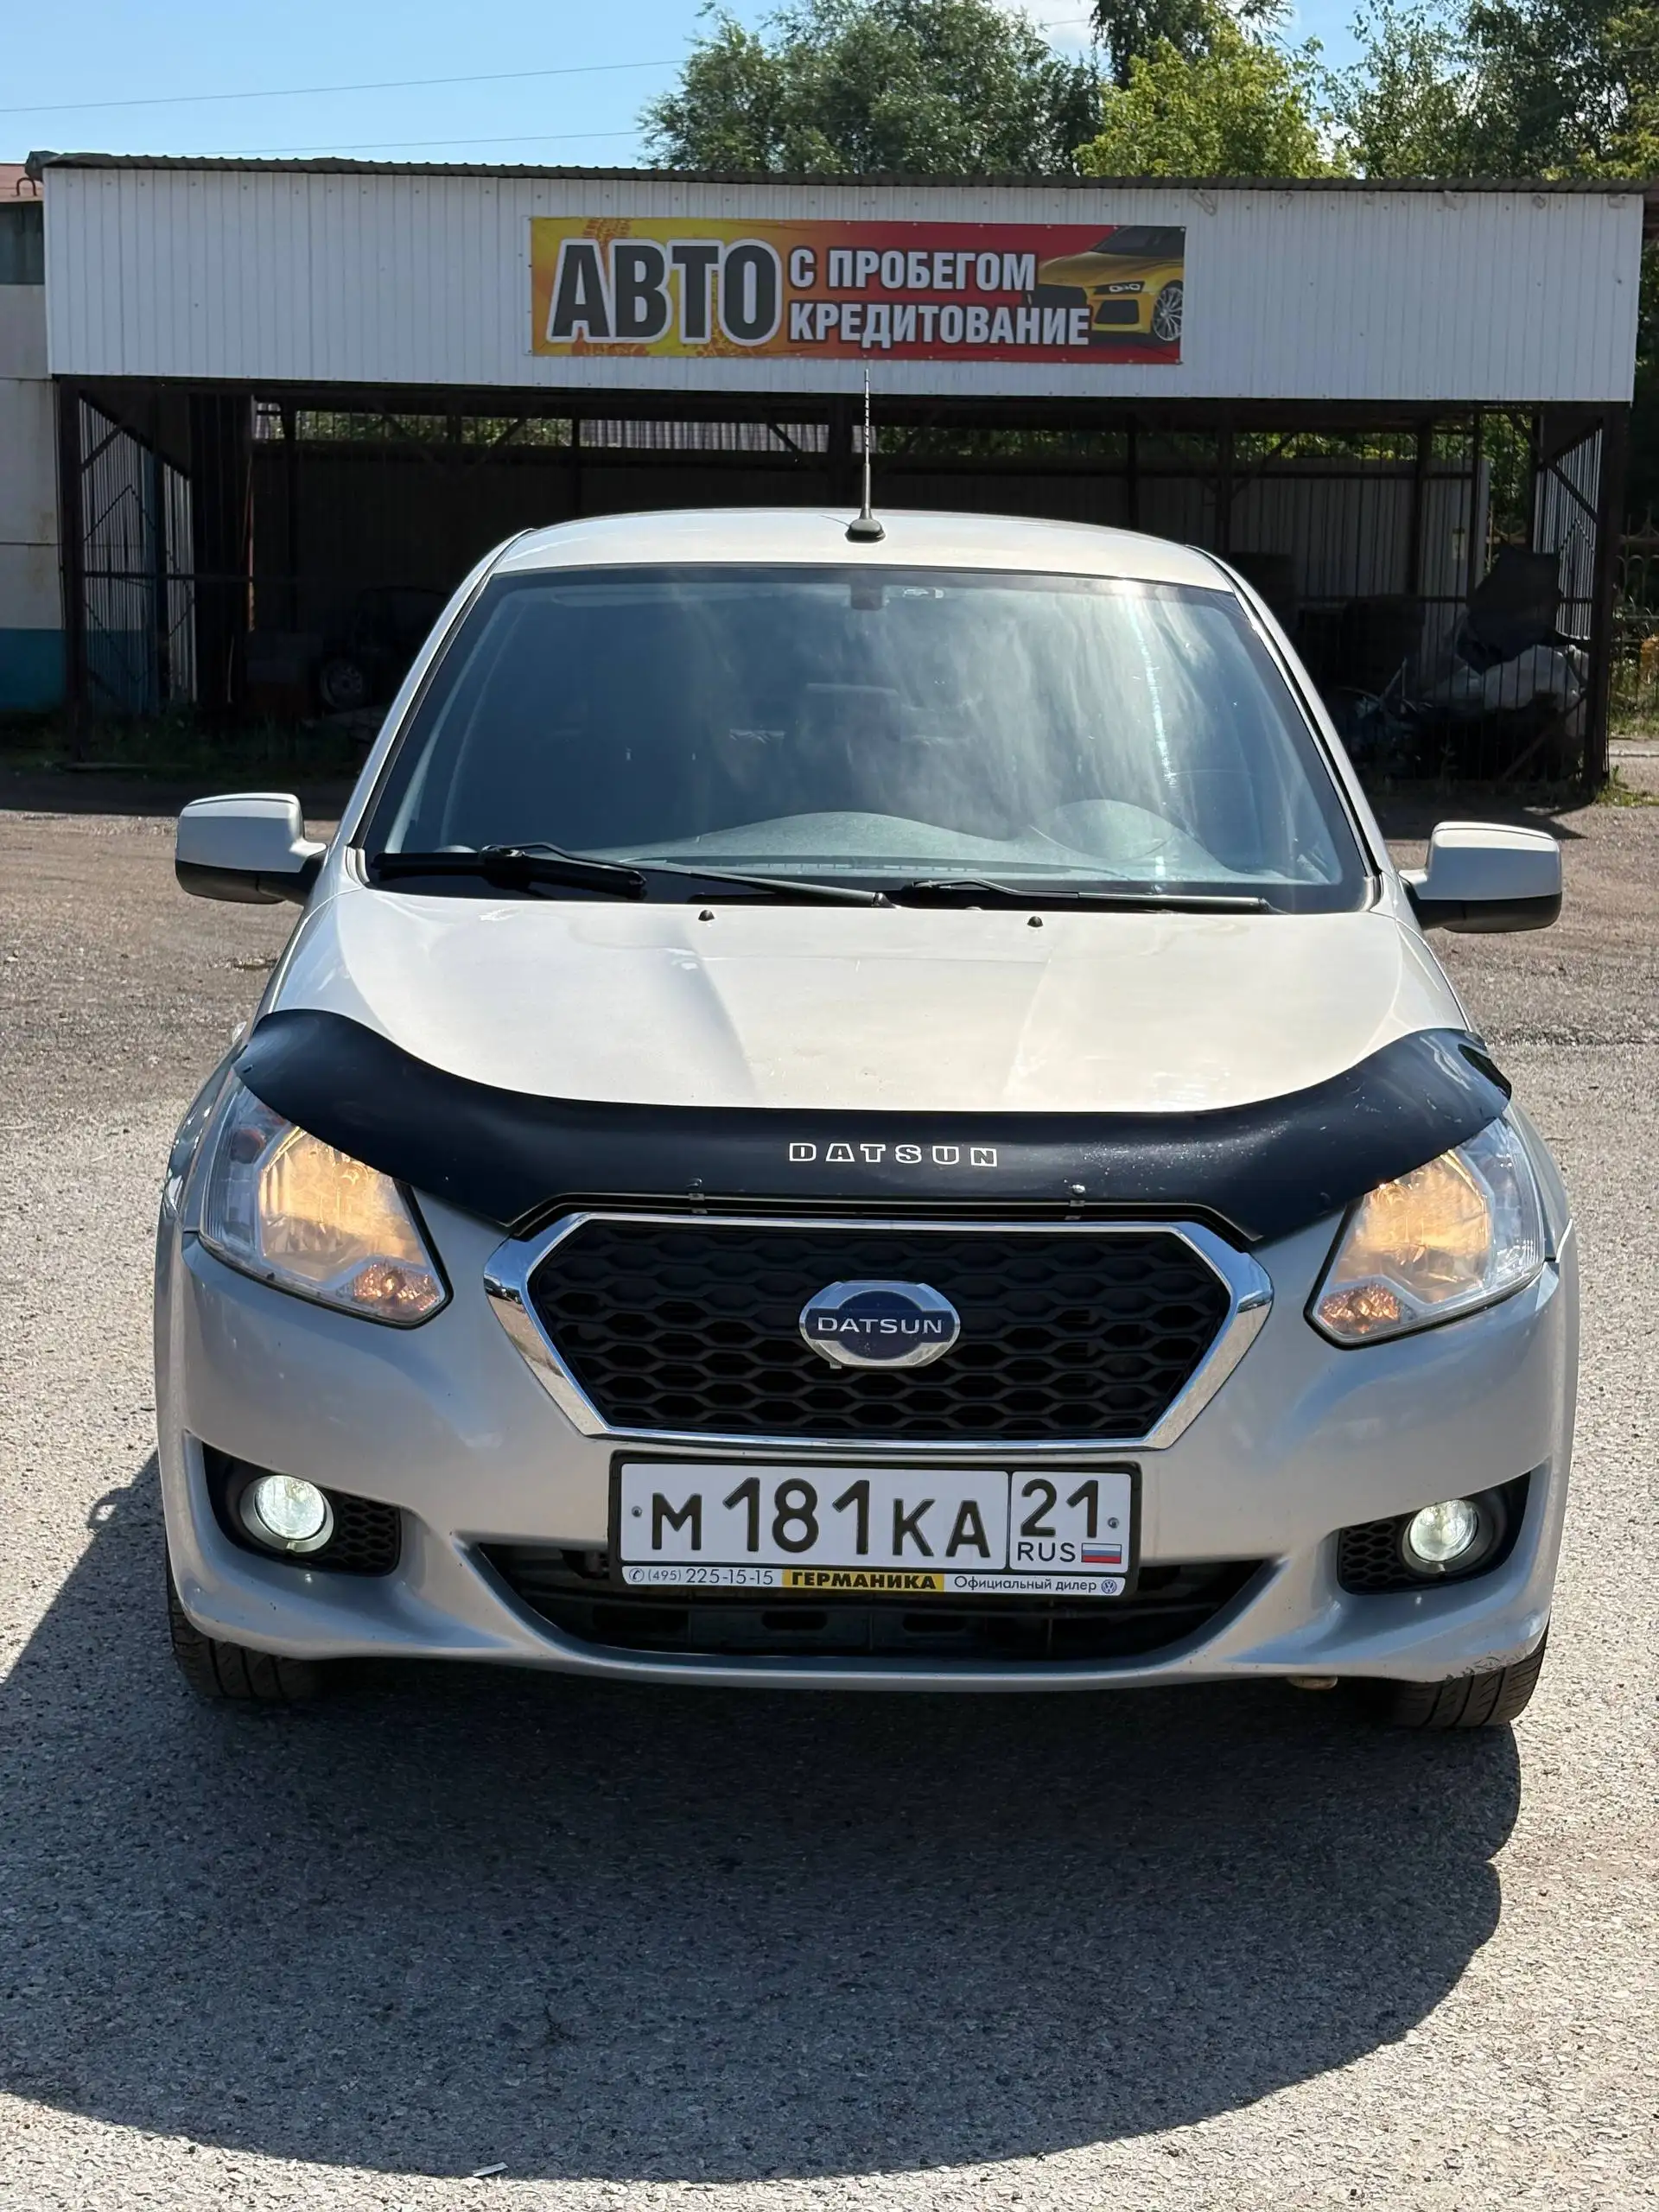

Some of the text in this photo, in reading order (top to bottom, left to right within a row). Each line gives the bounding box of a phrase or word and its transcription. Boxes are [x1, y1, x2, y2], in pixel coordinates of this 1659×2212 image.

[791, 249, 1036, 291] С ПРОБЕГОМ
[547, 239, 780, 343] АВТО
[790, 302, 1090, 348] КРЕДИТОВАНИЕ
[788, 1142, 998, 1167] DATSUN
[817, 1316, 943, 1334] DATSUN
[1020, 1478, 1099, 1538] 21
[1017, 1541, 1077, 1562] RUS
[648, 1568, 773, 1586] (495) 225-15-15
[791, 1571, 937, 1590] ГЕРМАНИКА
[954, 1575, 1098, 1592] Официальный дилер
